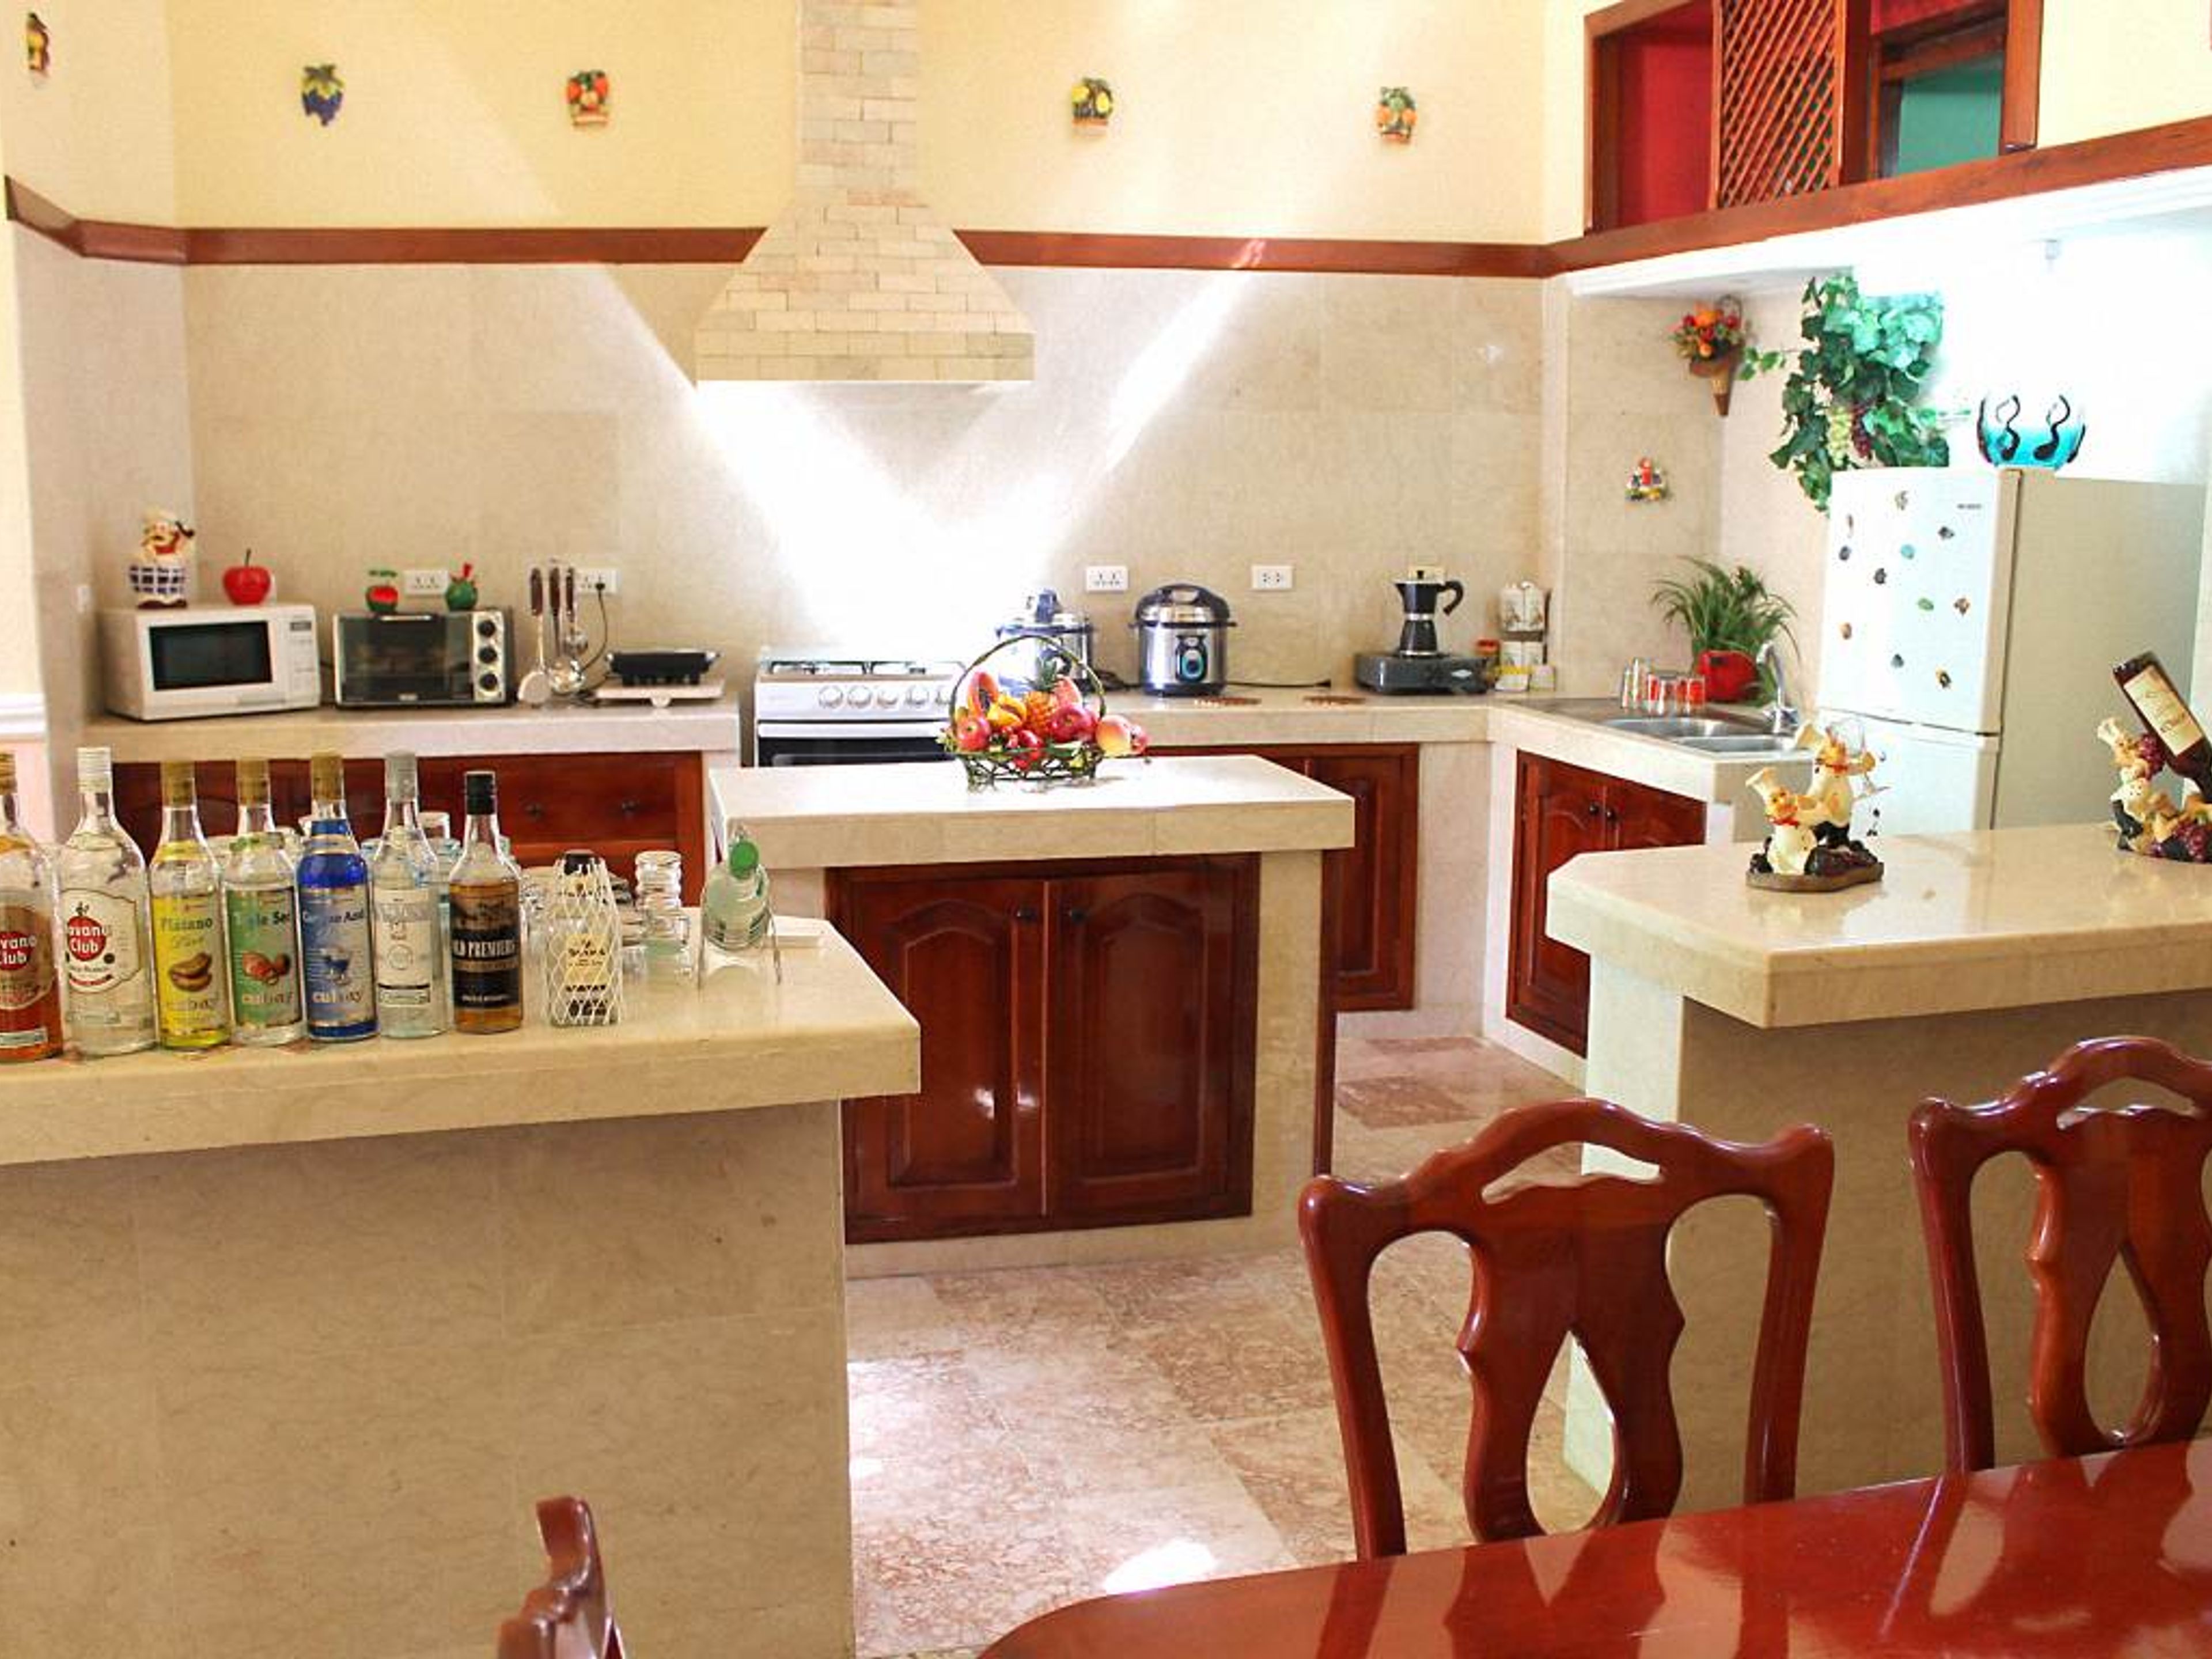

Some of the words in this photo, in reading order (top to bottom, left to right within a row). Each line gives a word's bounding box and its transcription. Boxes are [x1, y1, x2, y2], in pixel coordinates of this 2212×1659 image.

[69, 925, 113, 937] avana
[0, 934, 37, 949] vana
[70, 937, 99, 952] Club
[0, 950, 27, 965] lub
